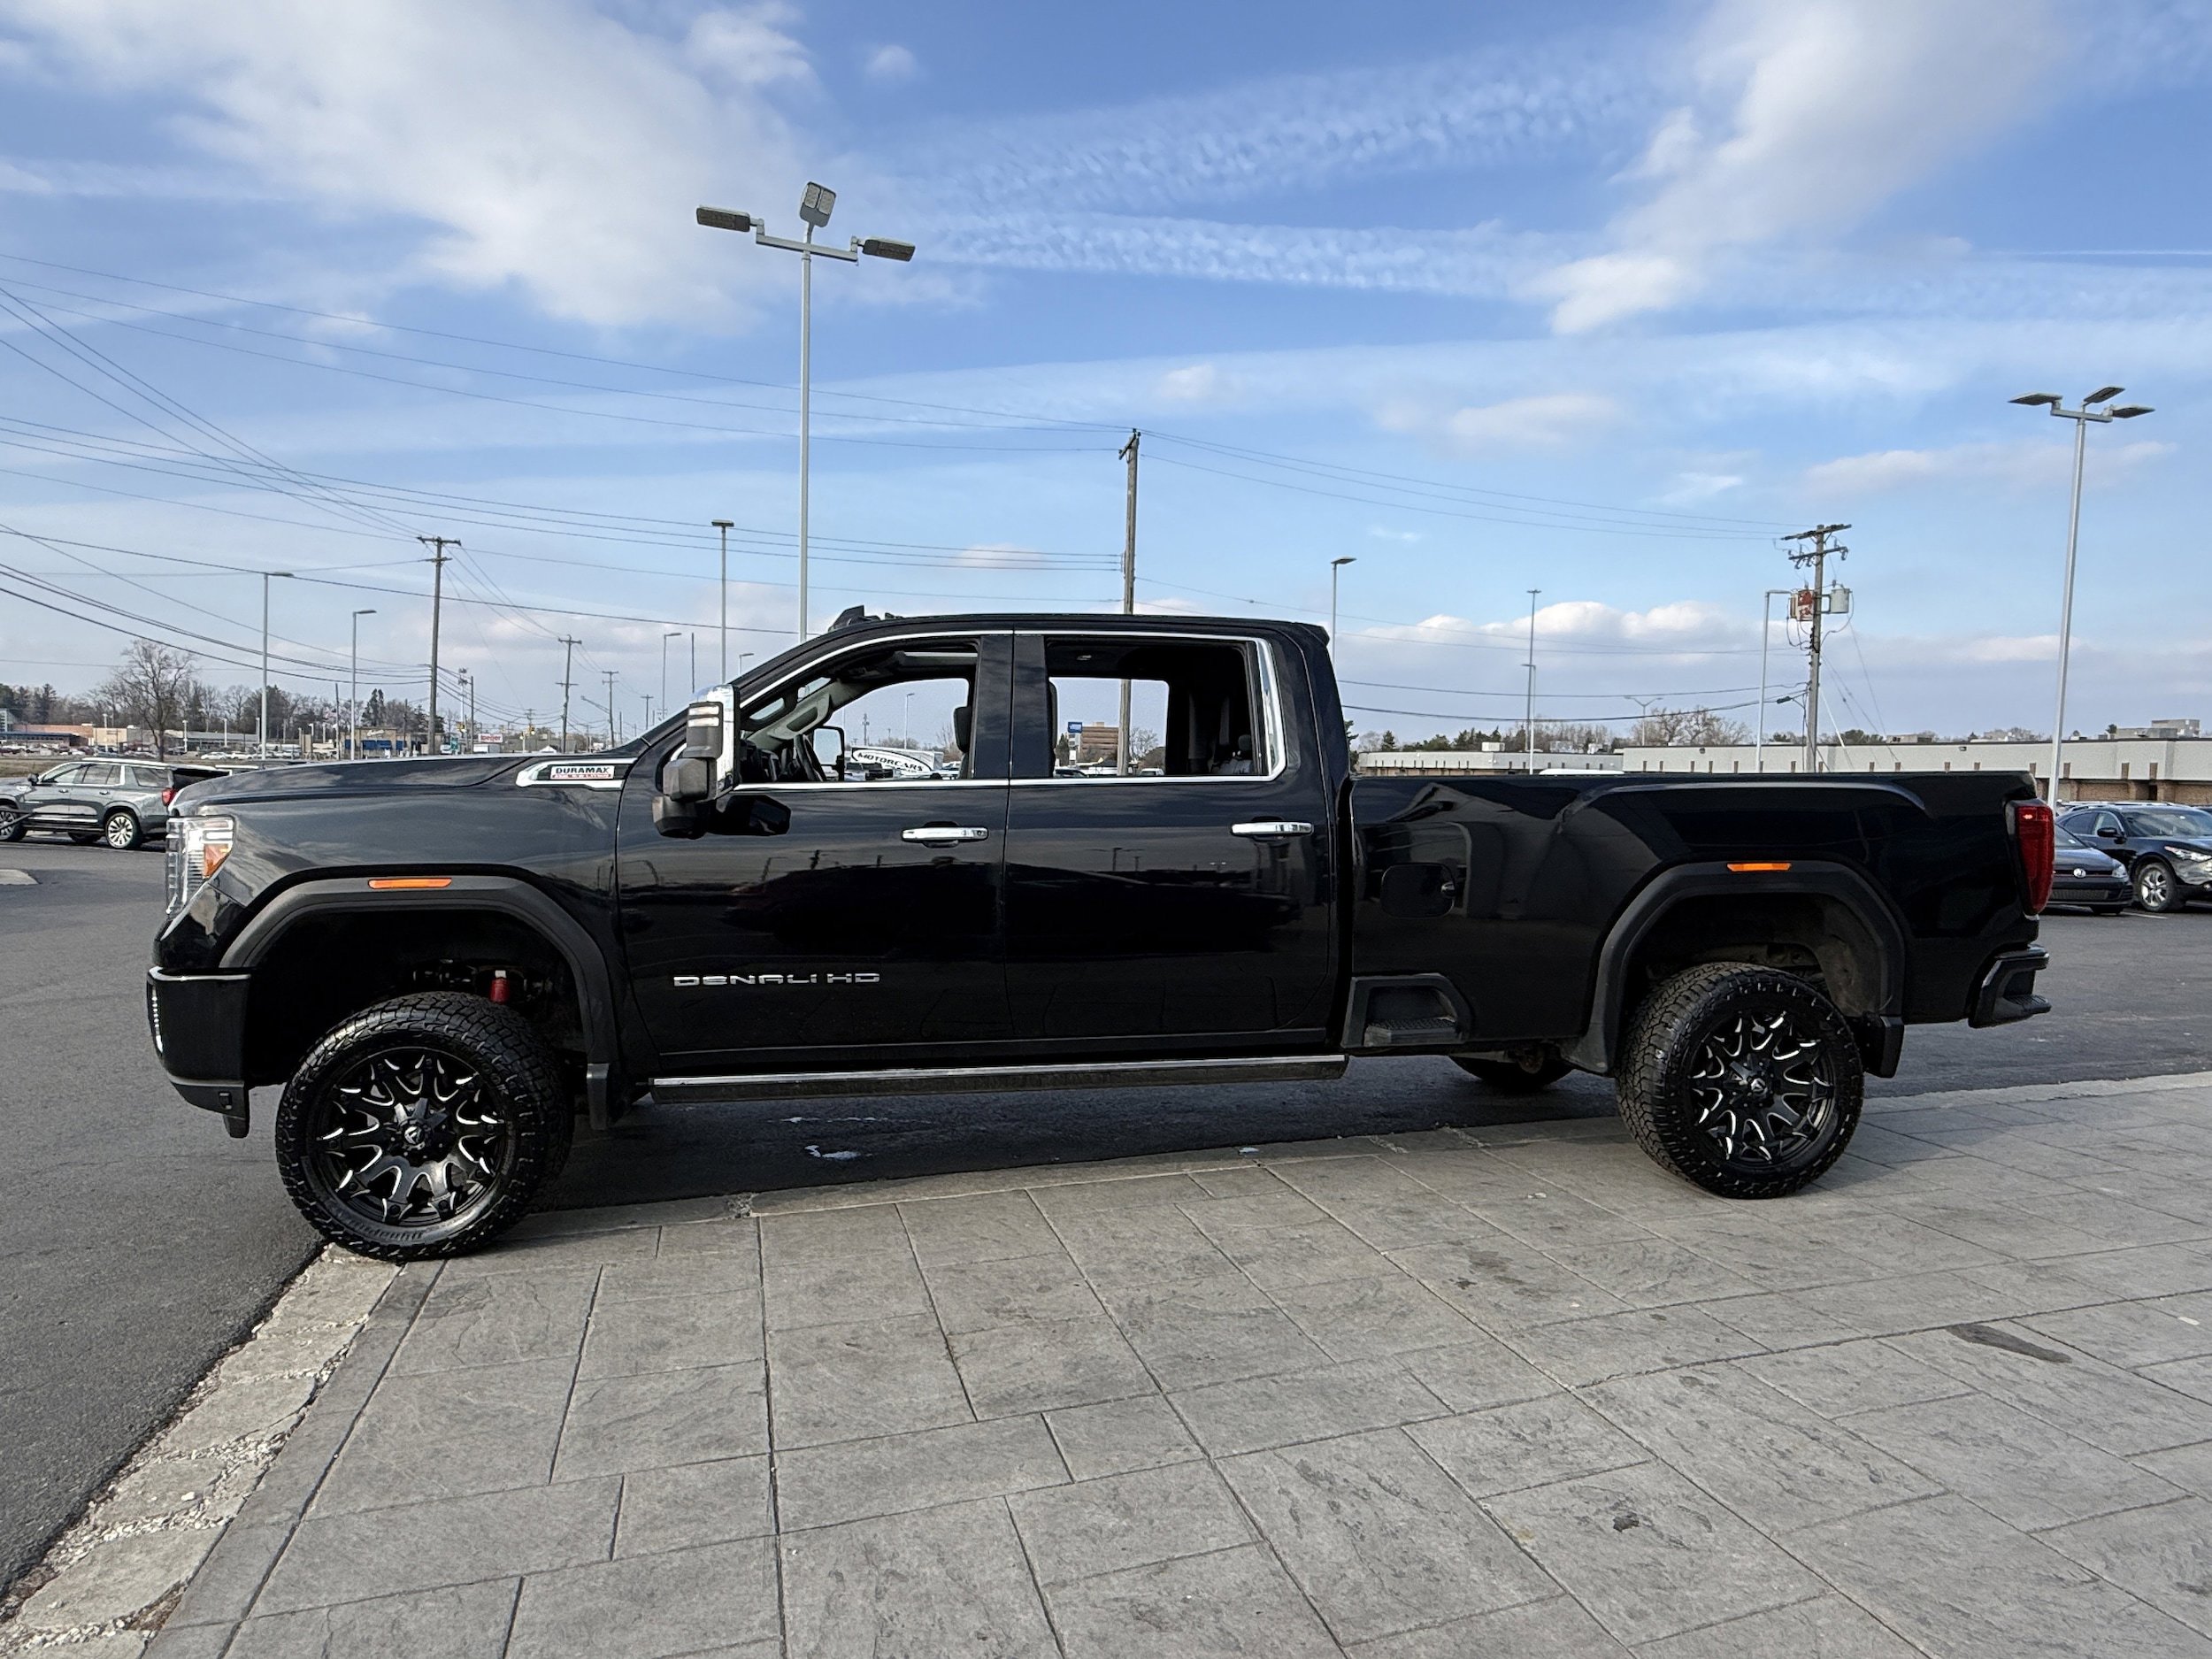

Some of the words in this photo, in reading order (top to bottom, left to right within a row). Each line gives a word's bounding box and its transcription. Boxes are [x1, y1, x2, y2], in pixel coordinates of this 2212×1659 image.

[856, 751, 924, 772] MOTORCARS
[673, 973, 818, 987] DENALI
[826, 972, 880, 984] HD
